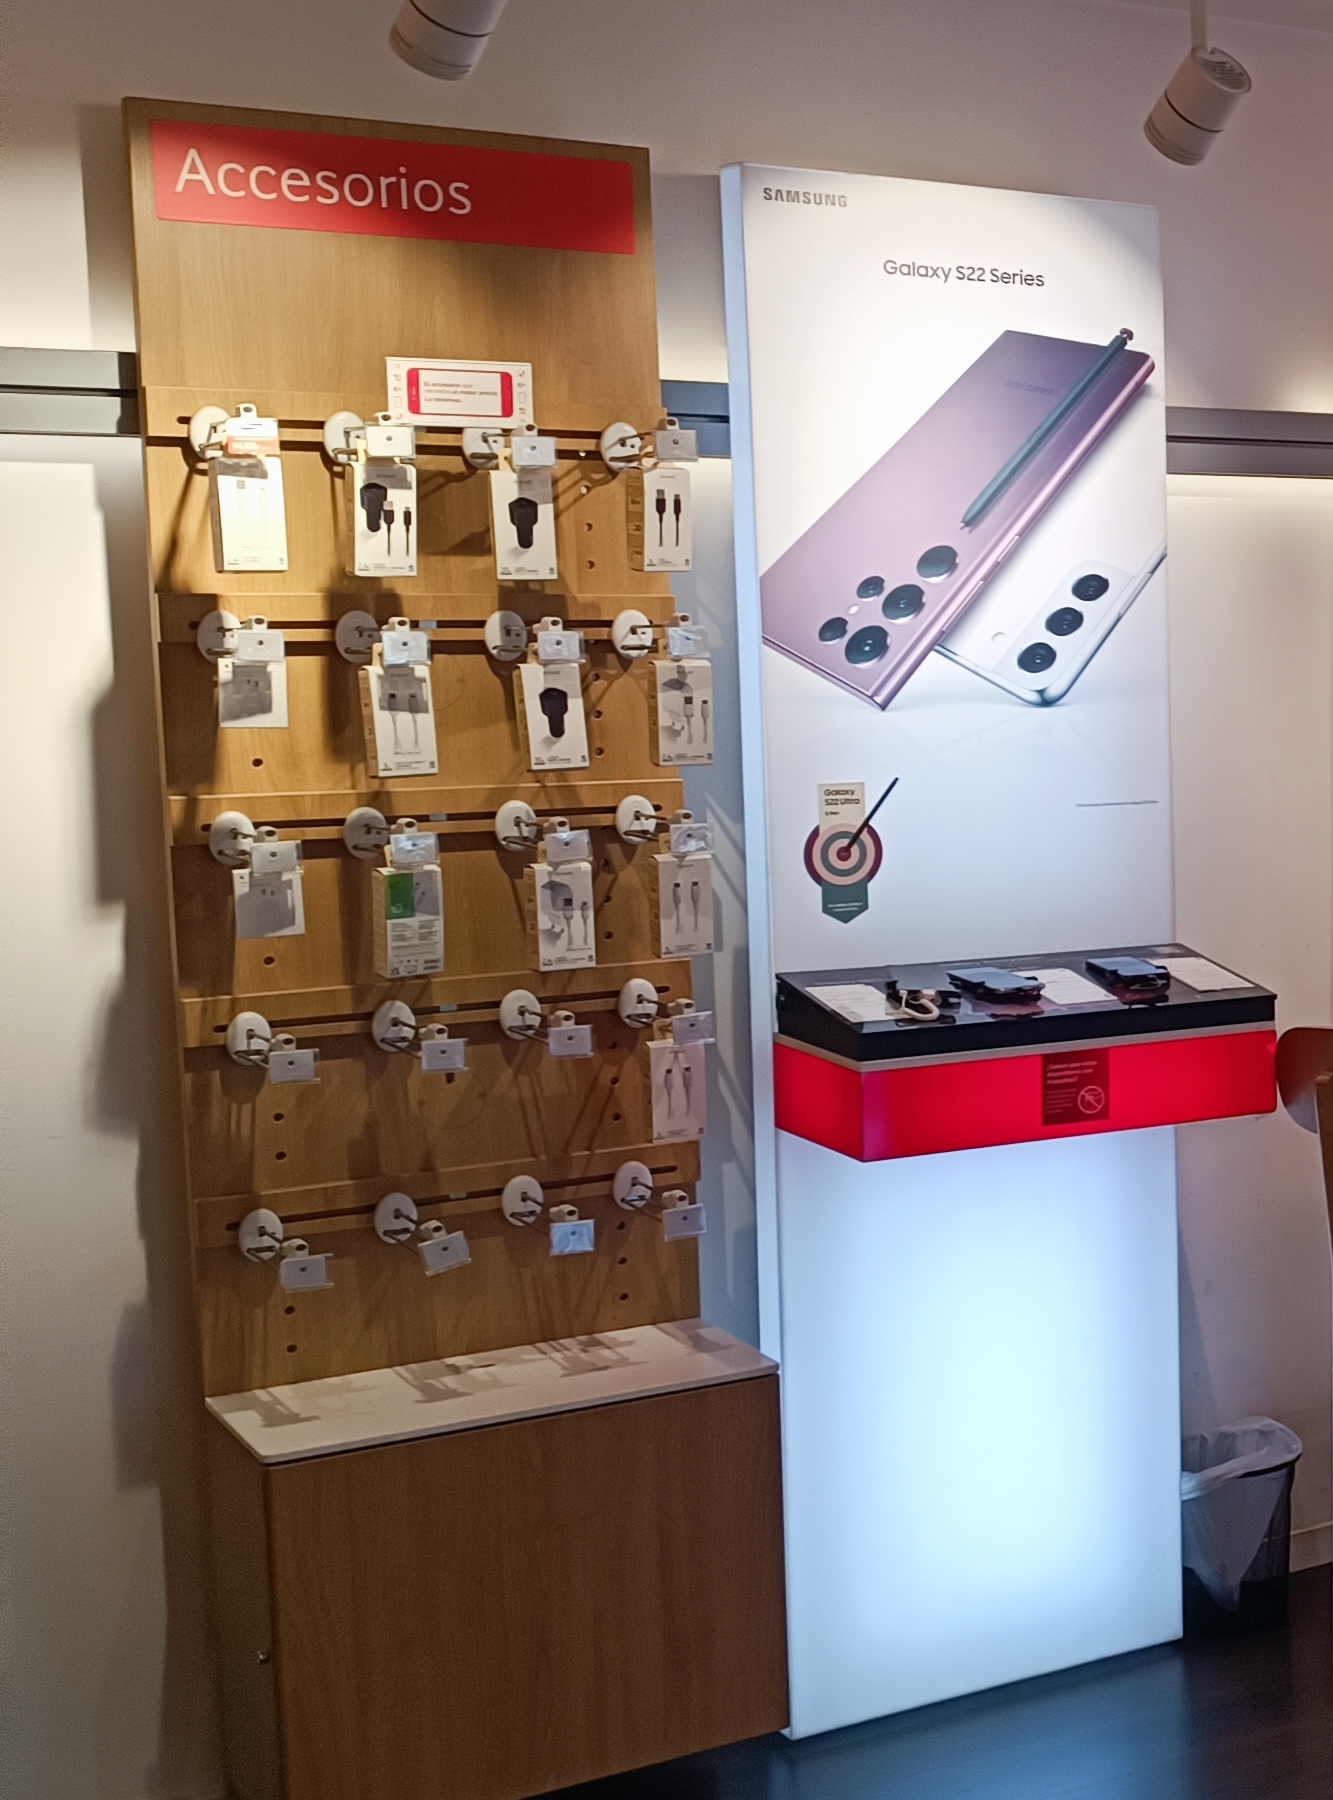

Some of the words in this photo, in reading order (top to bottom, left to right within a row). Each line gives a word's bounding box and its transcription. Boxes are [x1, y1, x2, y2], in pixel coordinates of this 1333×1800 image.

[174, 147, 473, 216] Accesorios
[762, 187, 849, 209] SAMSUNG
[882, 258, 952, 283] Galaxy
[955, 265, 986, 283] S22
[989, 268, 1046, 288] Series
